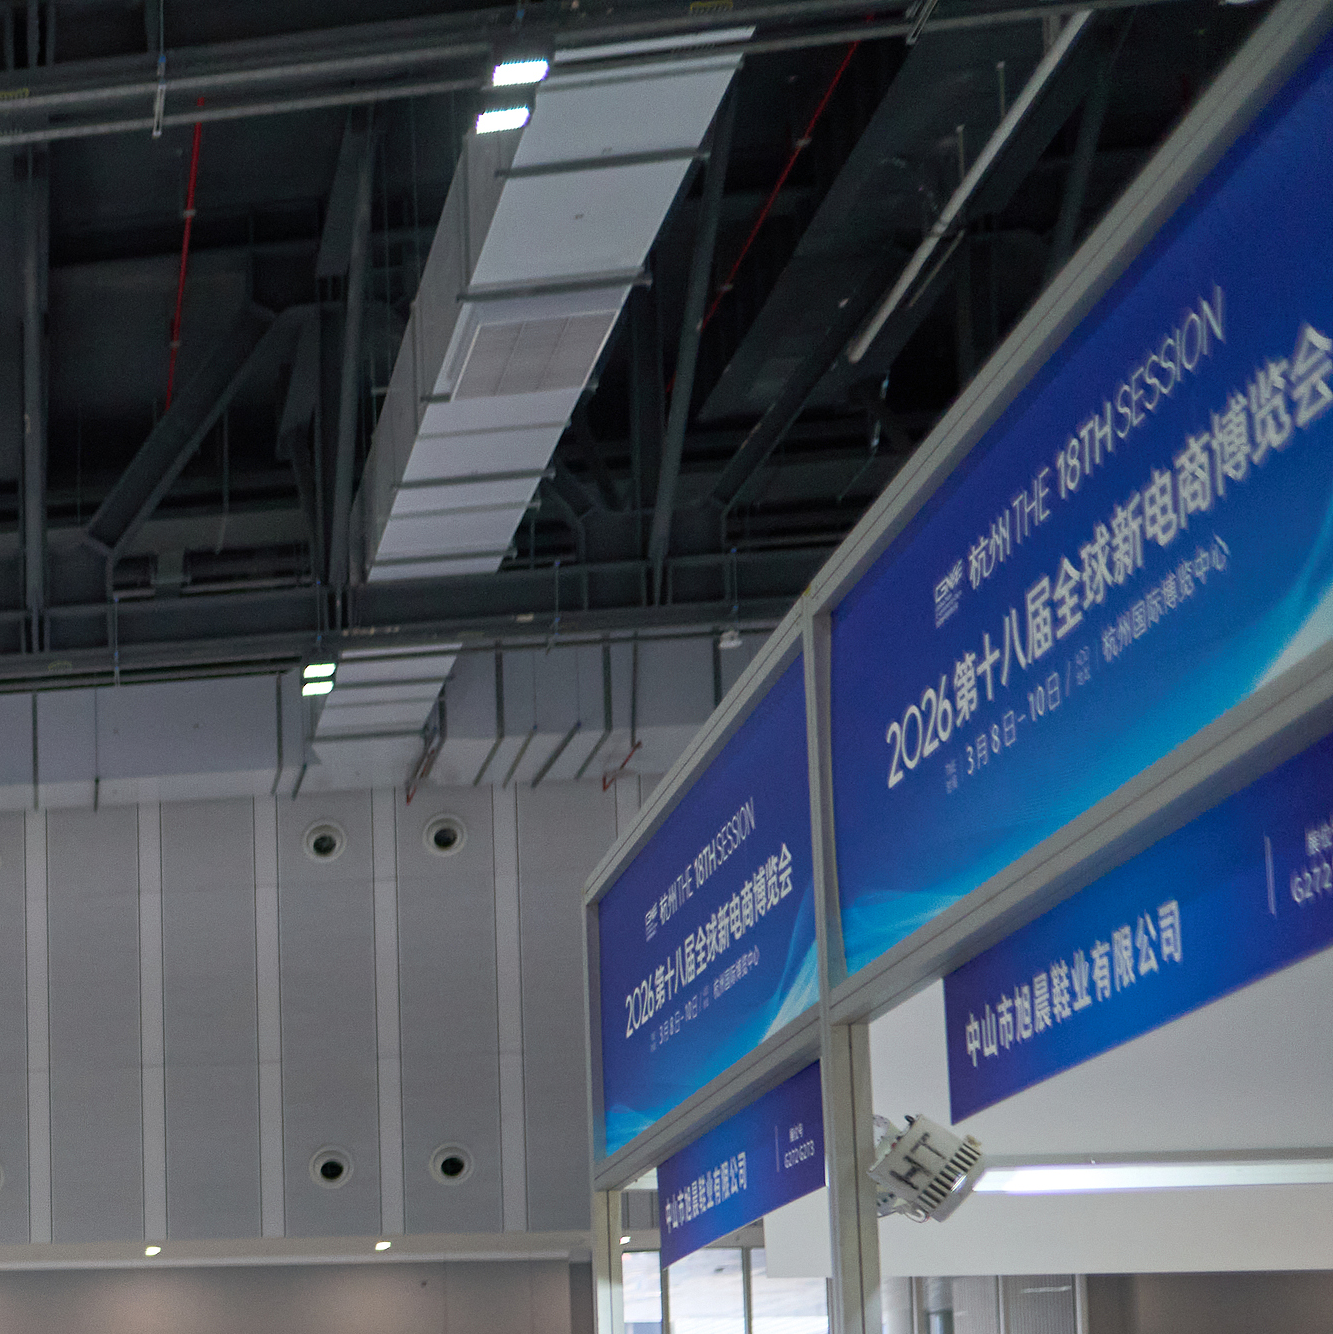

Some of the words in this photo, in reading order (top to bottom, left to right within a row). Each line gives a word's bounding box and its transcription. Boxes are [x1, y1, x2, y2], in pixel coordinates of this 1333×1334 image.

[885, 323, 1333, 789] 2026第十八届全球新电商博览会
[968, 519, 1012, 590] 杭州
[1013, 468, 1052, 544] THE
[1054, 403, 1113, 500] 18TH
[1113, 285, 1227, 442] SESSION
[625, 843, 794, 1039] 2026第十八届全球新电商博览会
[677, 864, 694, 908] THE
[694, 838, 717, 889] 18TH
[717, 797, 756, 867] SESSION
